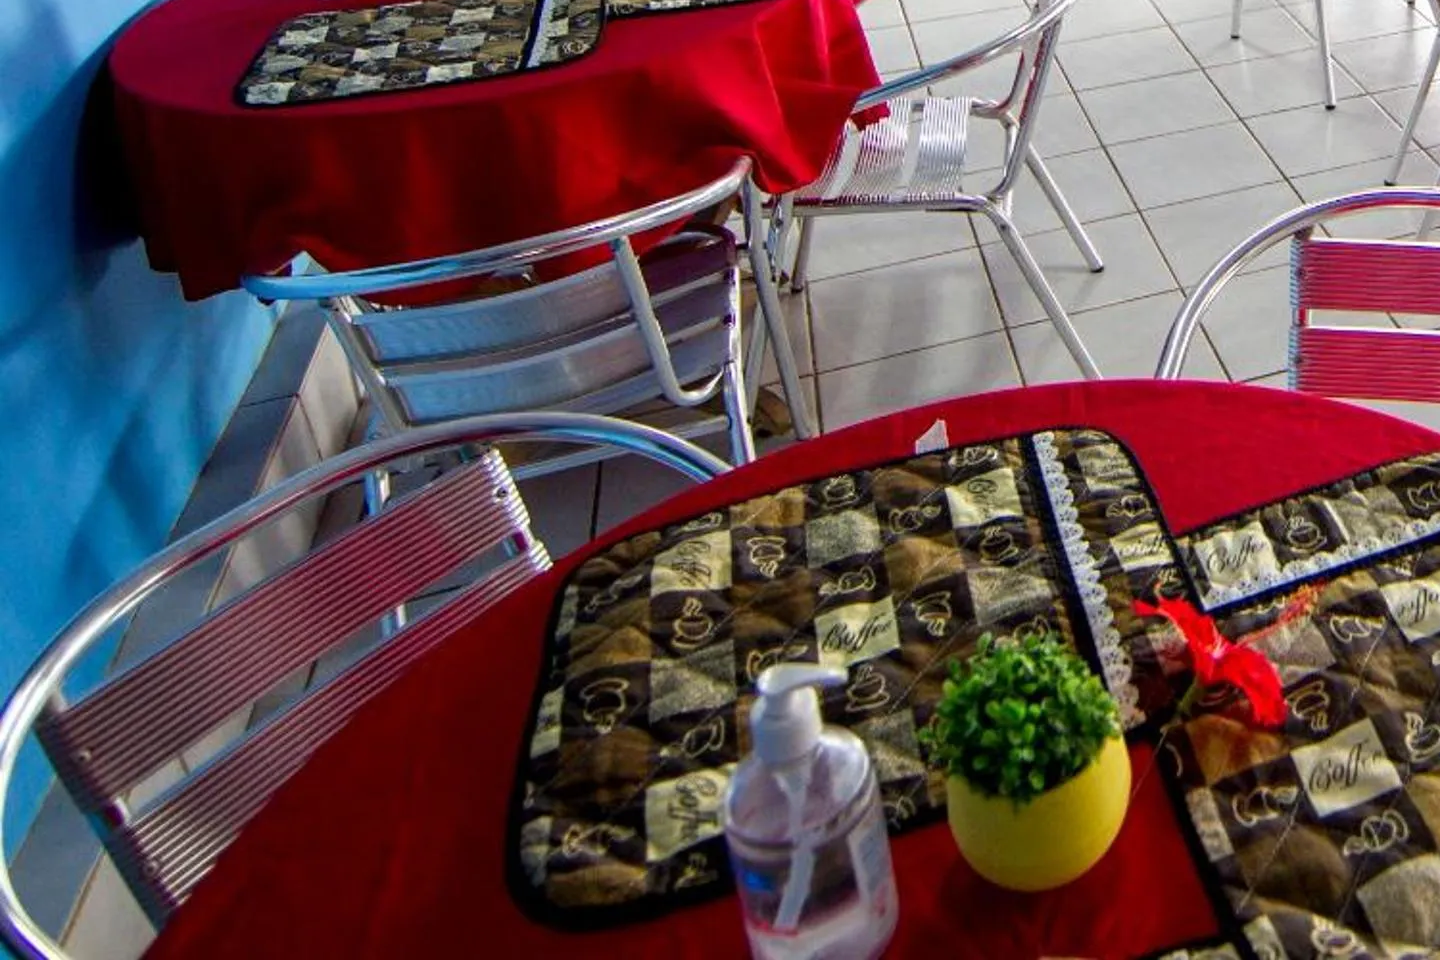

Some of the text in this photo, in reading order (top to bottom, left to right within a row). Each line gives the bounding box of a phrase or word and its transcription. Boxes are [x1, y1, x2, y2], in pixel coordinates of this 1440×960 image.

[1207, 535, 1266, 574] Coffee
[822, 615, 892, 653] Coffee
[1309, 738, 1382, 794] Coffee
